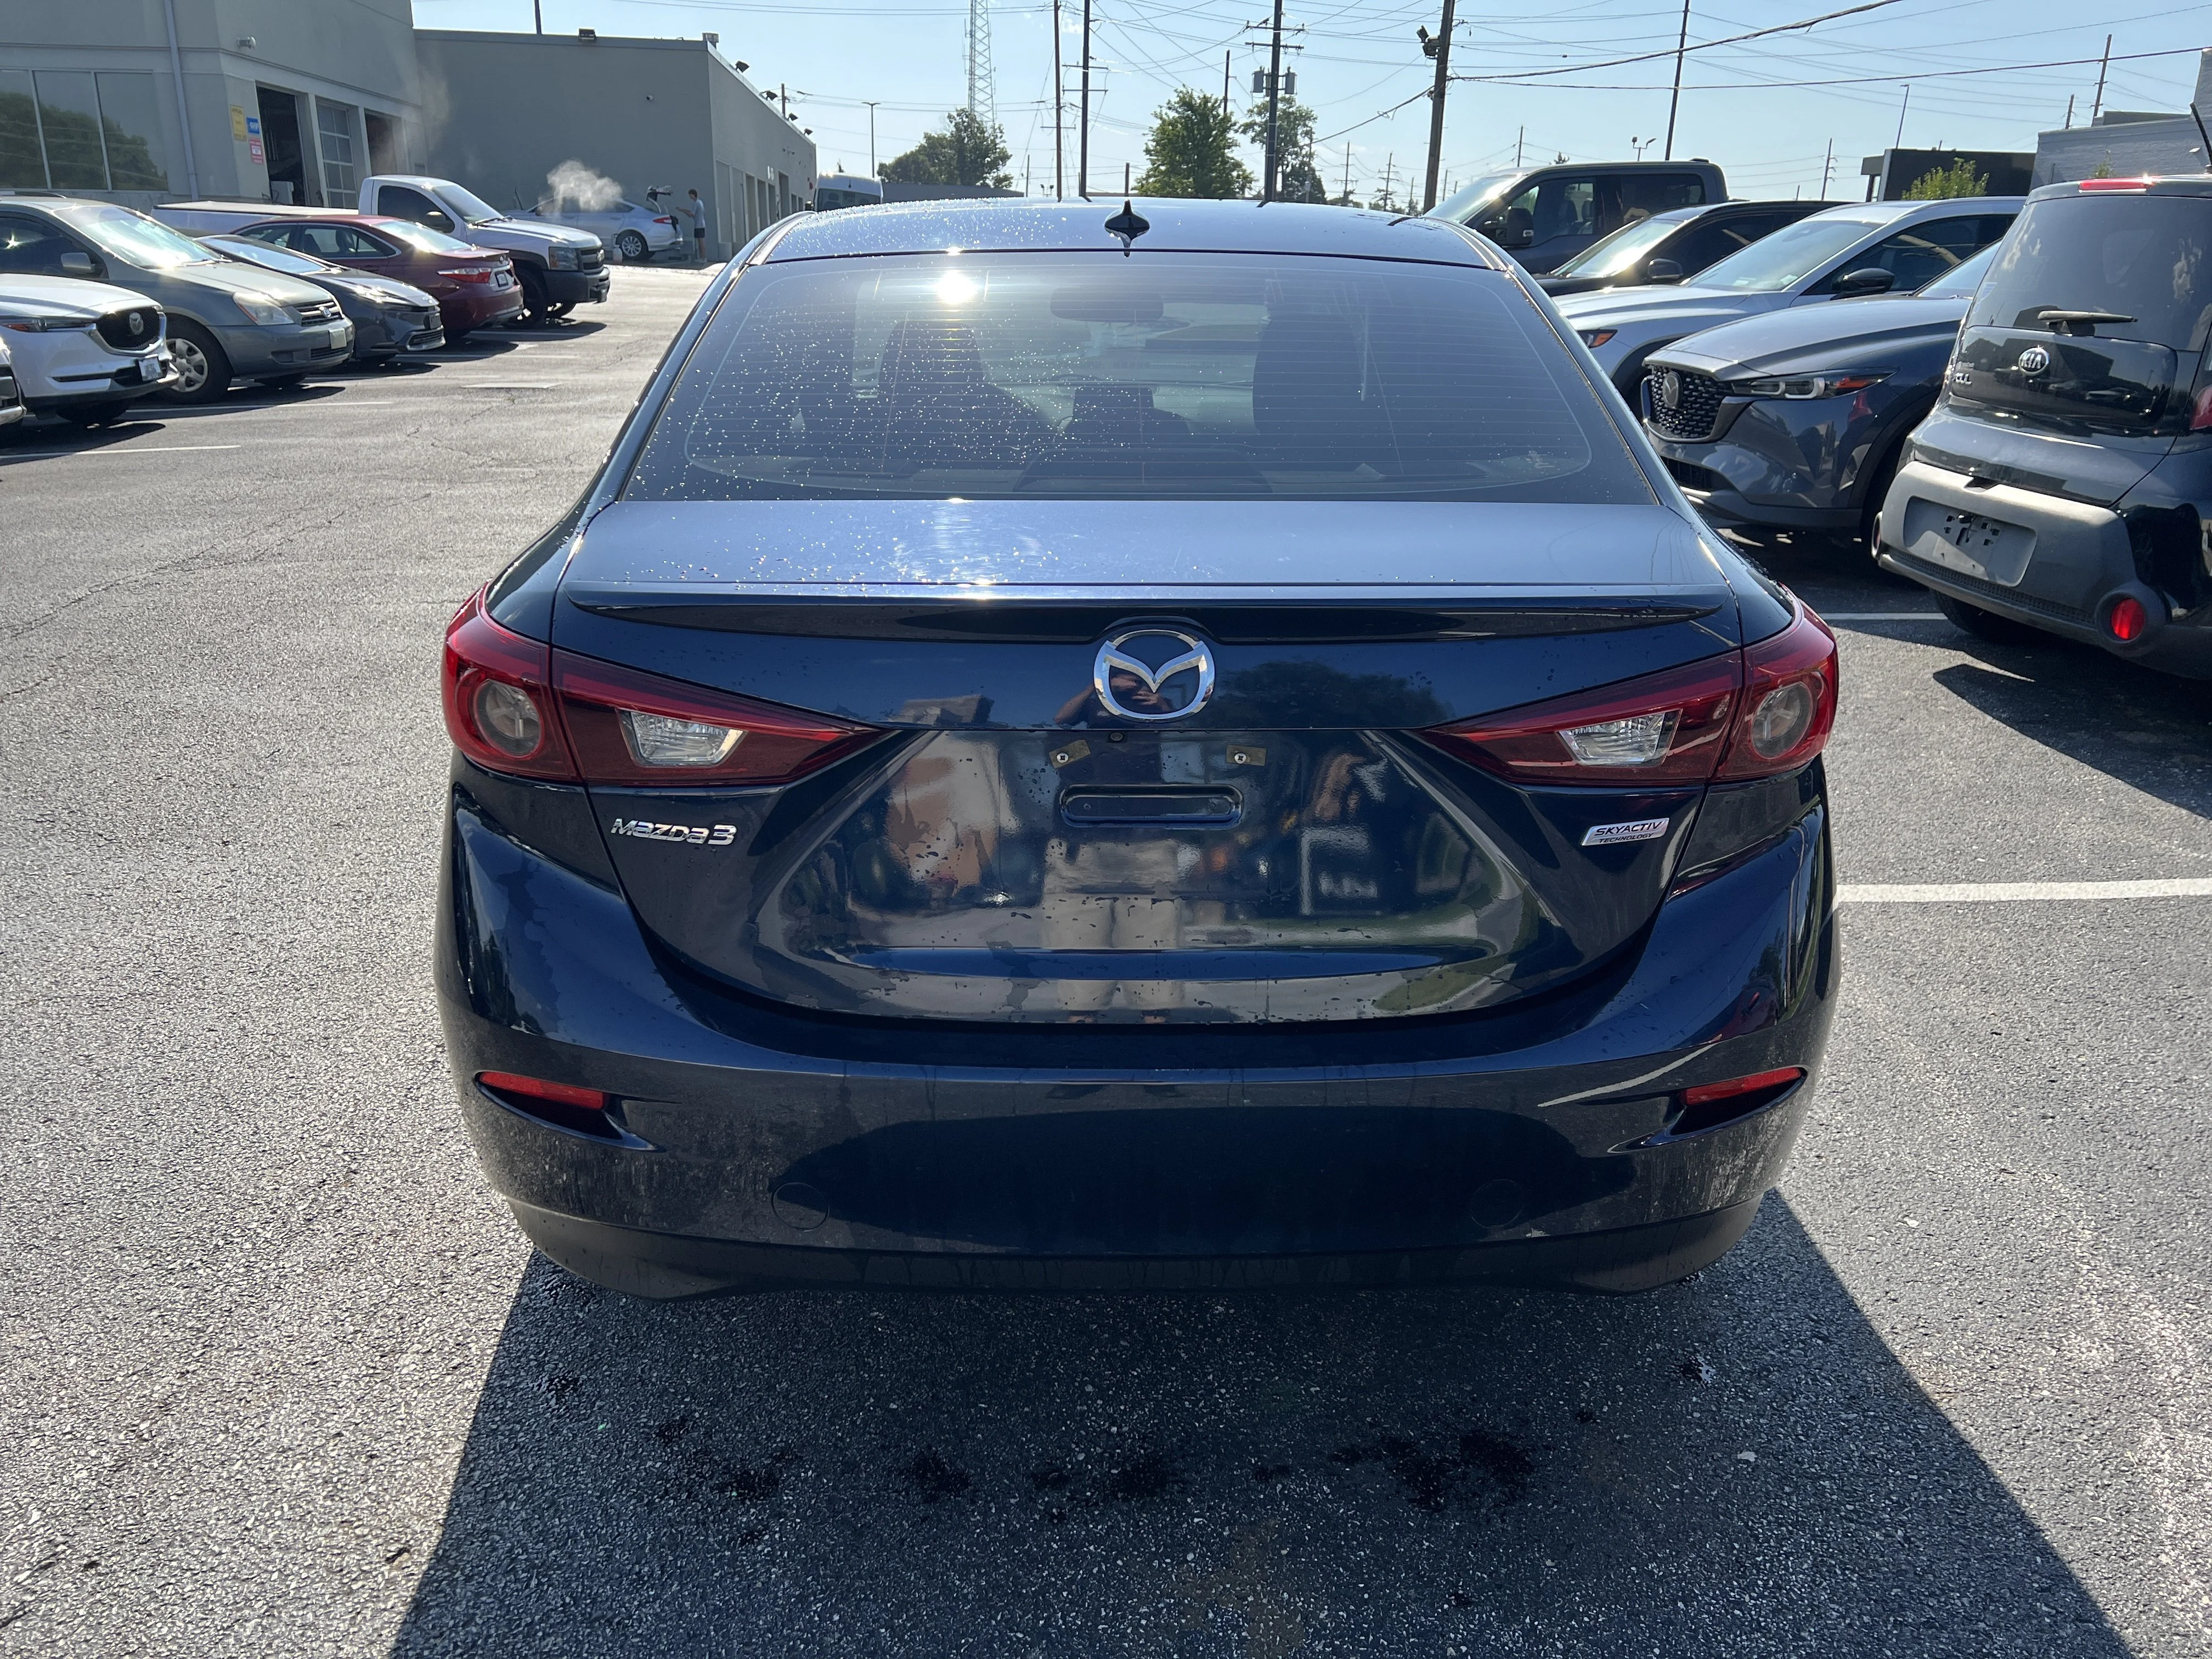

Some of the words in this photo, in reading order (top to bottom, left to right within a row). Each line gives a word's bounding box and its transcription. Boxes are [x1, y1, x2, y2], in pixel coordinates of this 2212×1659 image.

[2021, 352, 2042, 369] KIA
[1594, 821, 1663, 837] SKYACTIV
[1599, 832, 1655, 844] TECHNOLOGY
